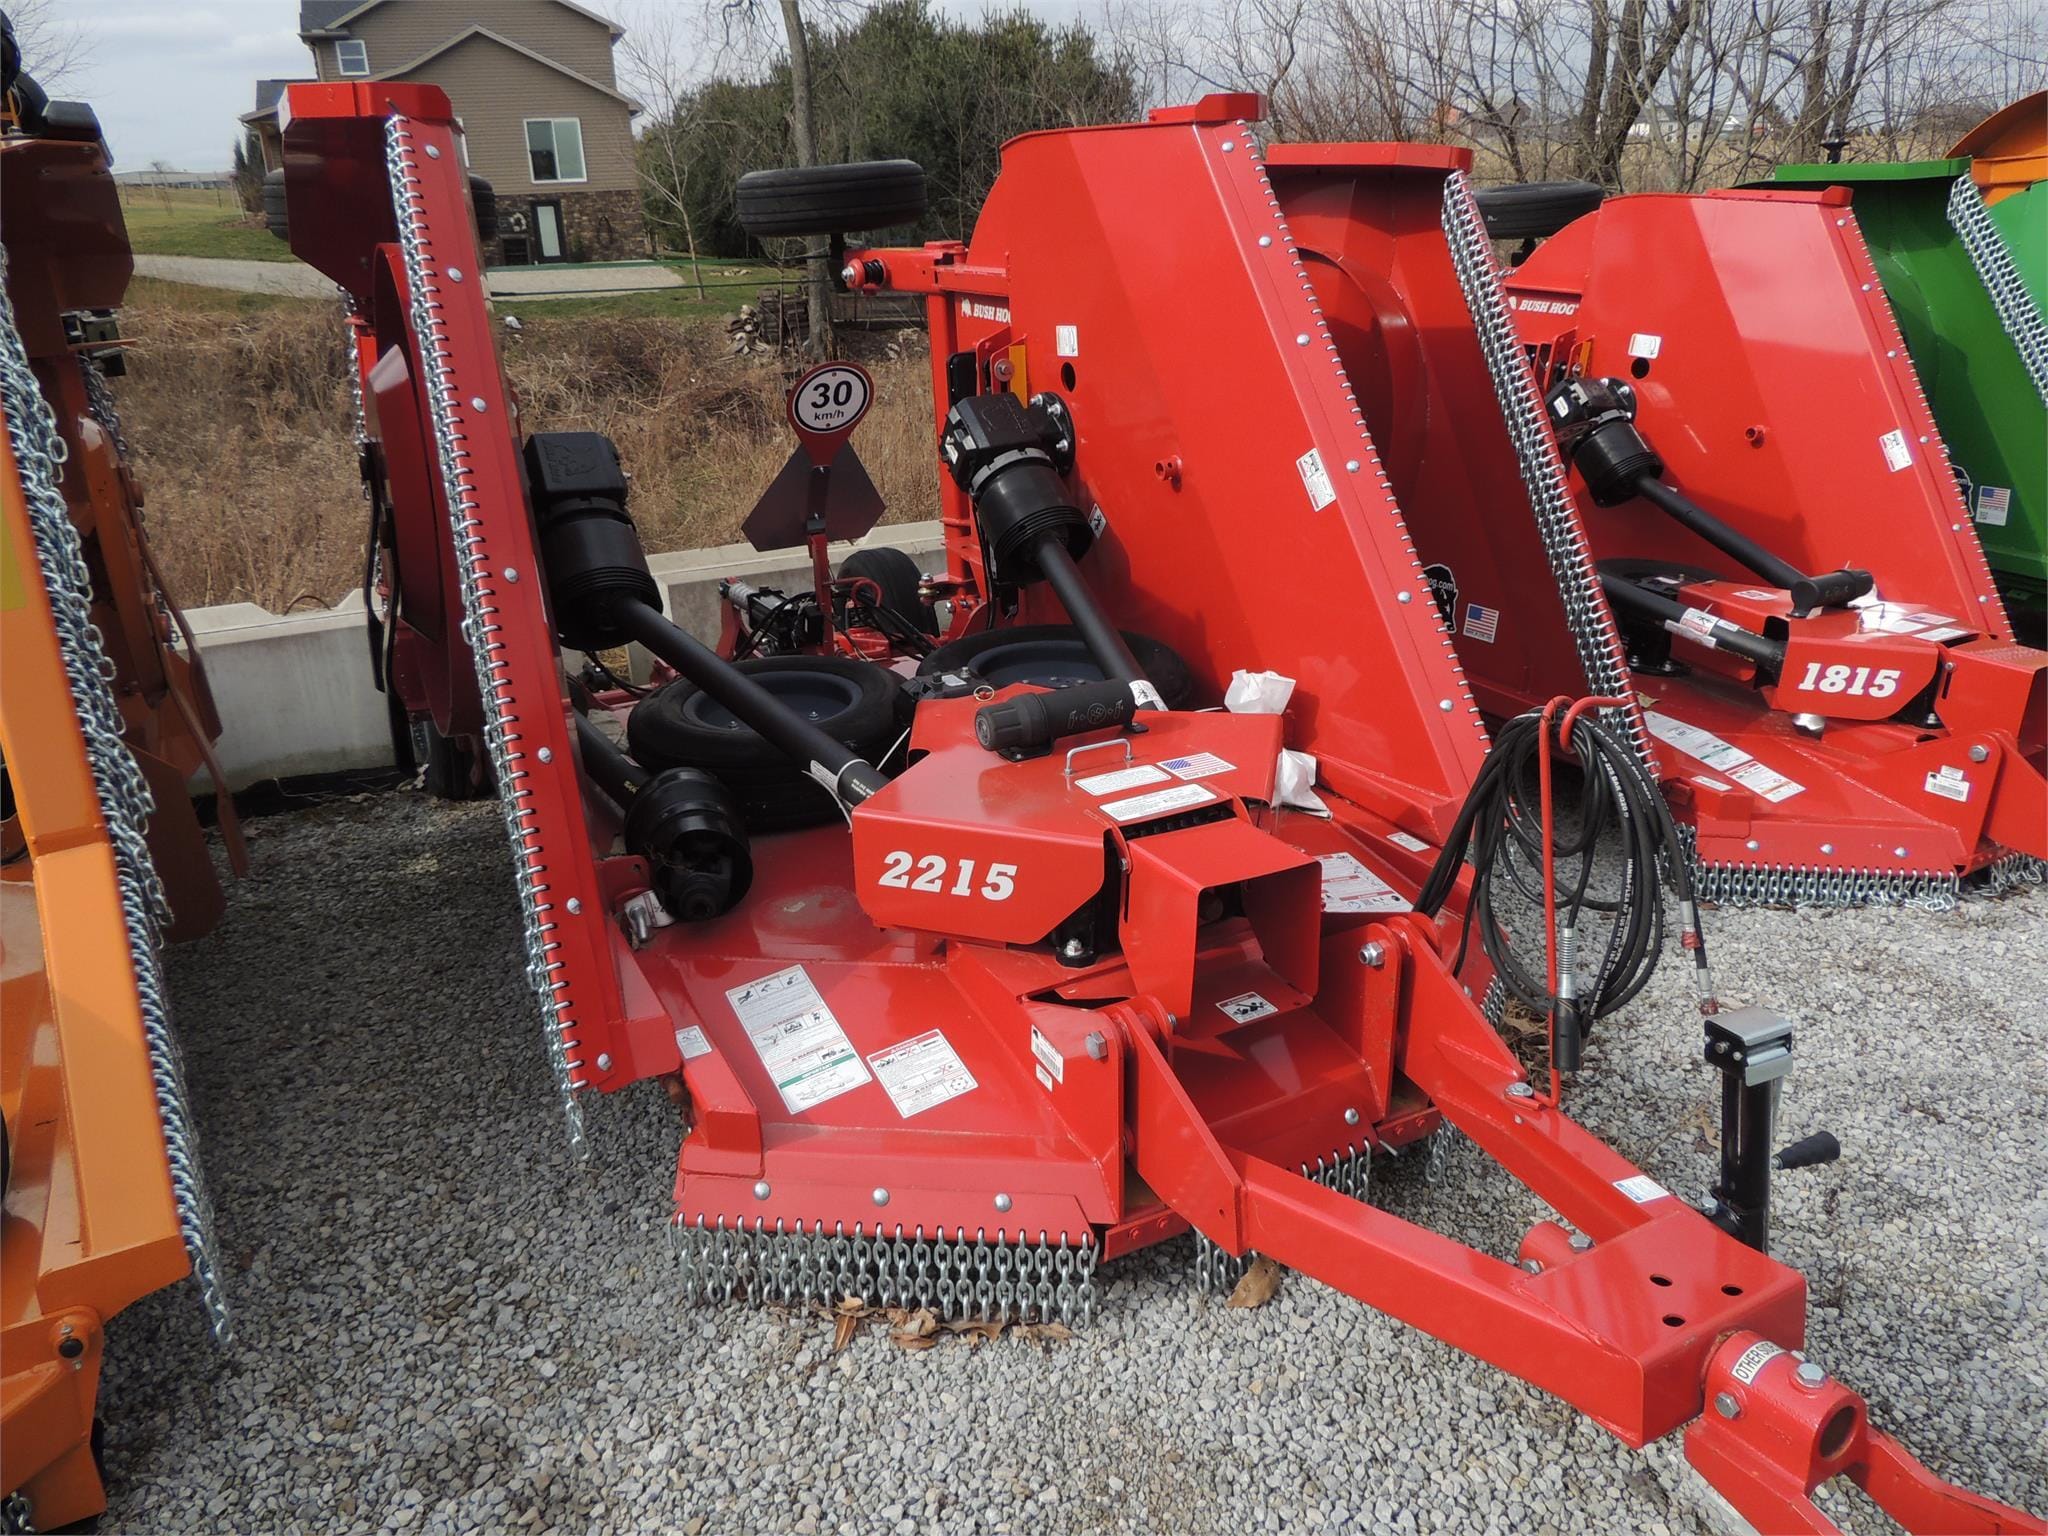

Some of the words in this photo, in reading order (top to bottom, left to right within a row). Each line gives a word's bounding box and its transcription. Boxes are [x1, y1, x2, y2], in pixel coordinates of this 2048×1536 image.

[973, 303, 995, 321] BUSH
[1519, 300, 1550, 313] BUSH
[1548, 302, 1576, 316] HOG
[811, 380, 853, 409] 30
[814, 409, 845, 421] km/h
[1428, 577, 1454, 591] og.com
[1798, 662, 1901, 698] 1815
[878, 850, 1018, 901] 2215
[1735, 1349, 1766, 1379] OTHER
